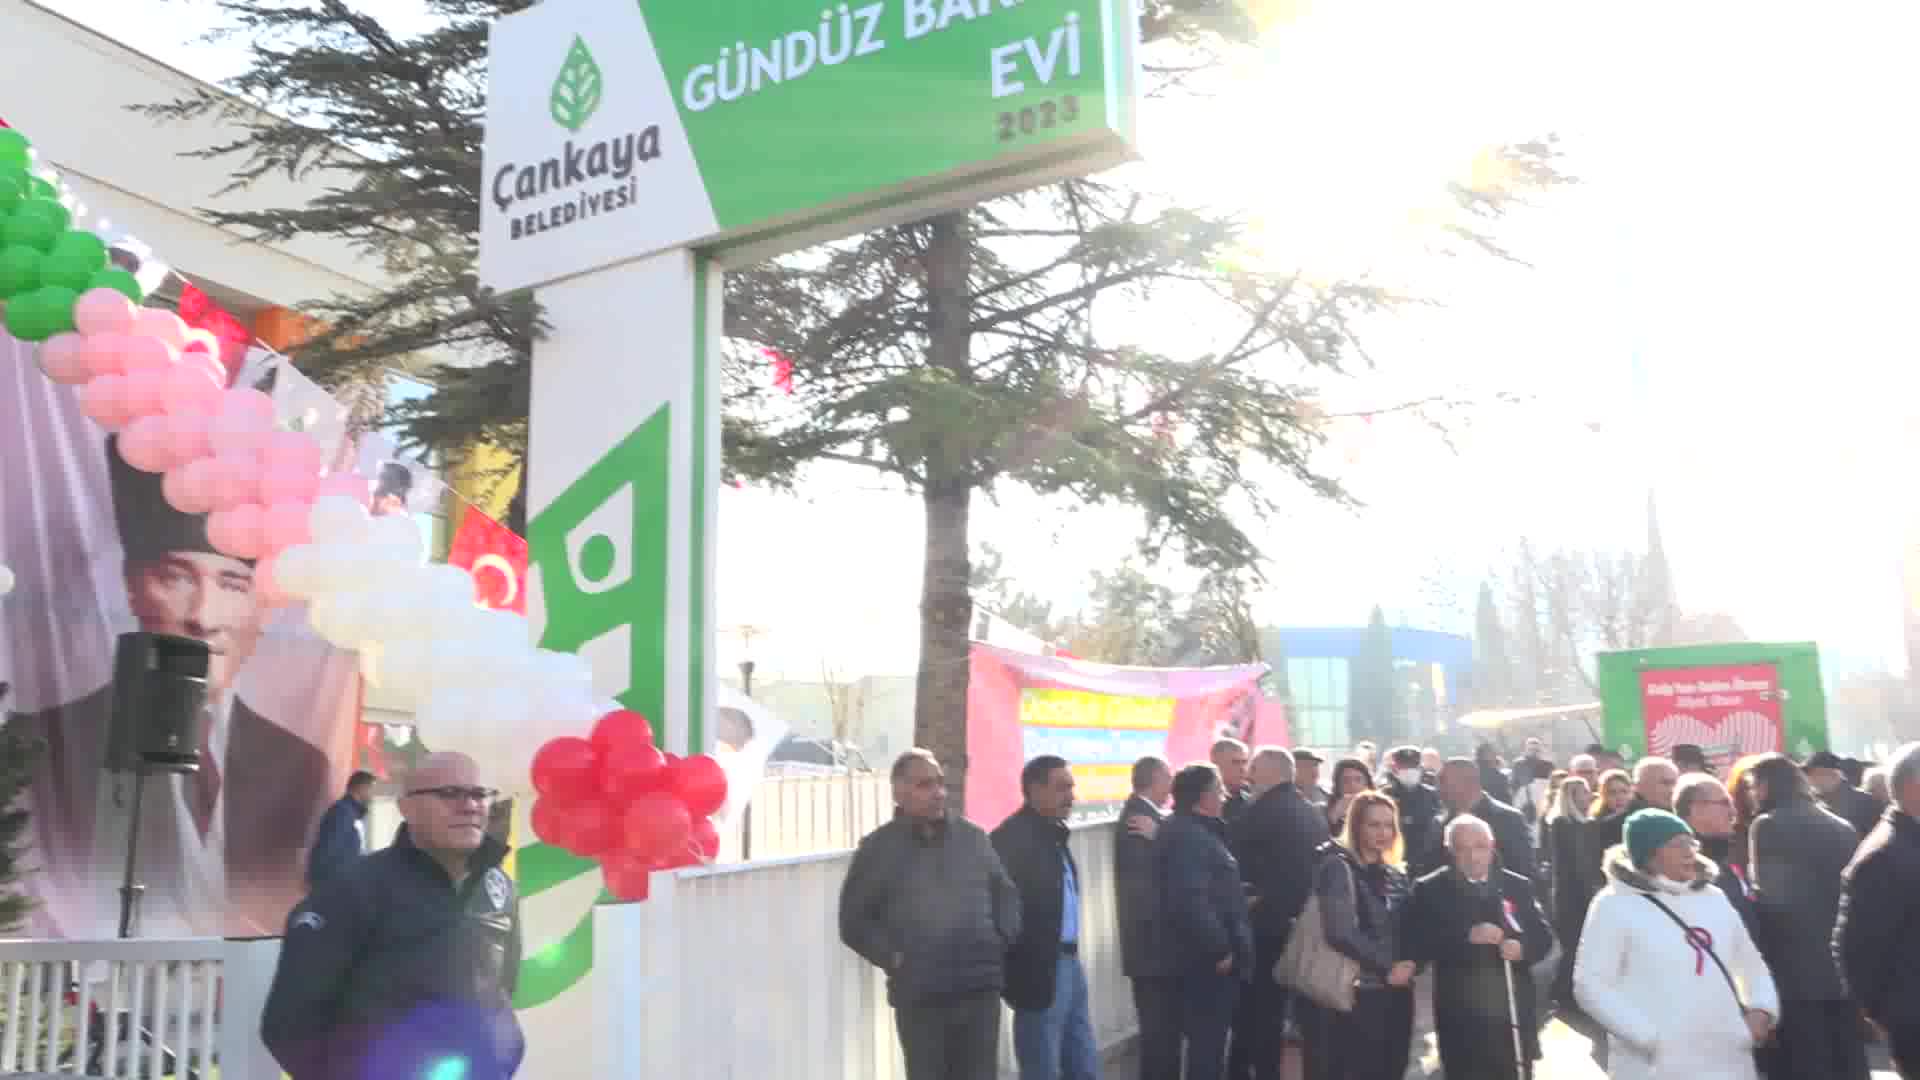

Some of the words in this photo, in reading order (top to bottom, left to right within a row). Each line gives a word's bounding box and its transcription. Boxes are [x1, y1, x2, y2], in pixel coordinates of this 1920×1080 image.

[684, 1, 886, 111] GÜNDÜZ
[991, 11, 1080, 97] EVİ
[997, 95, 1079, 142] 2023
[492, 124, 662, 212] Çankaya
[510, 176, 637, 240] BELEDİYESİ
